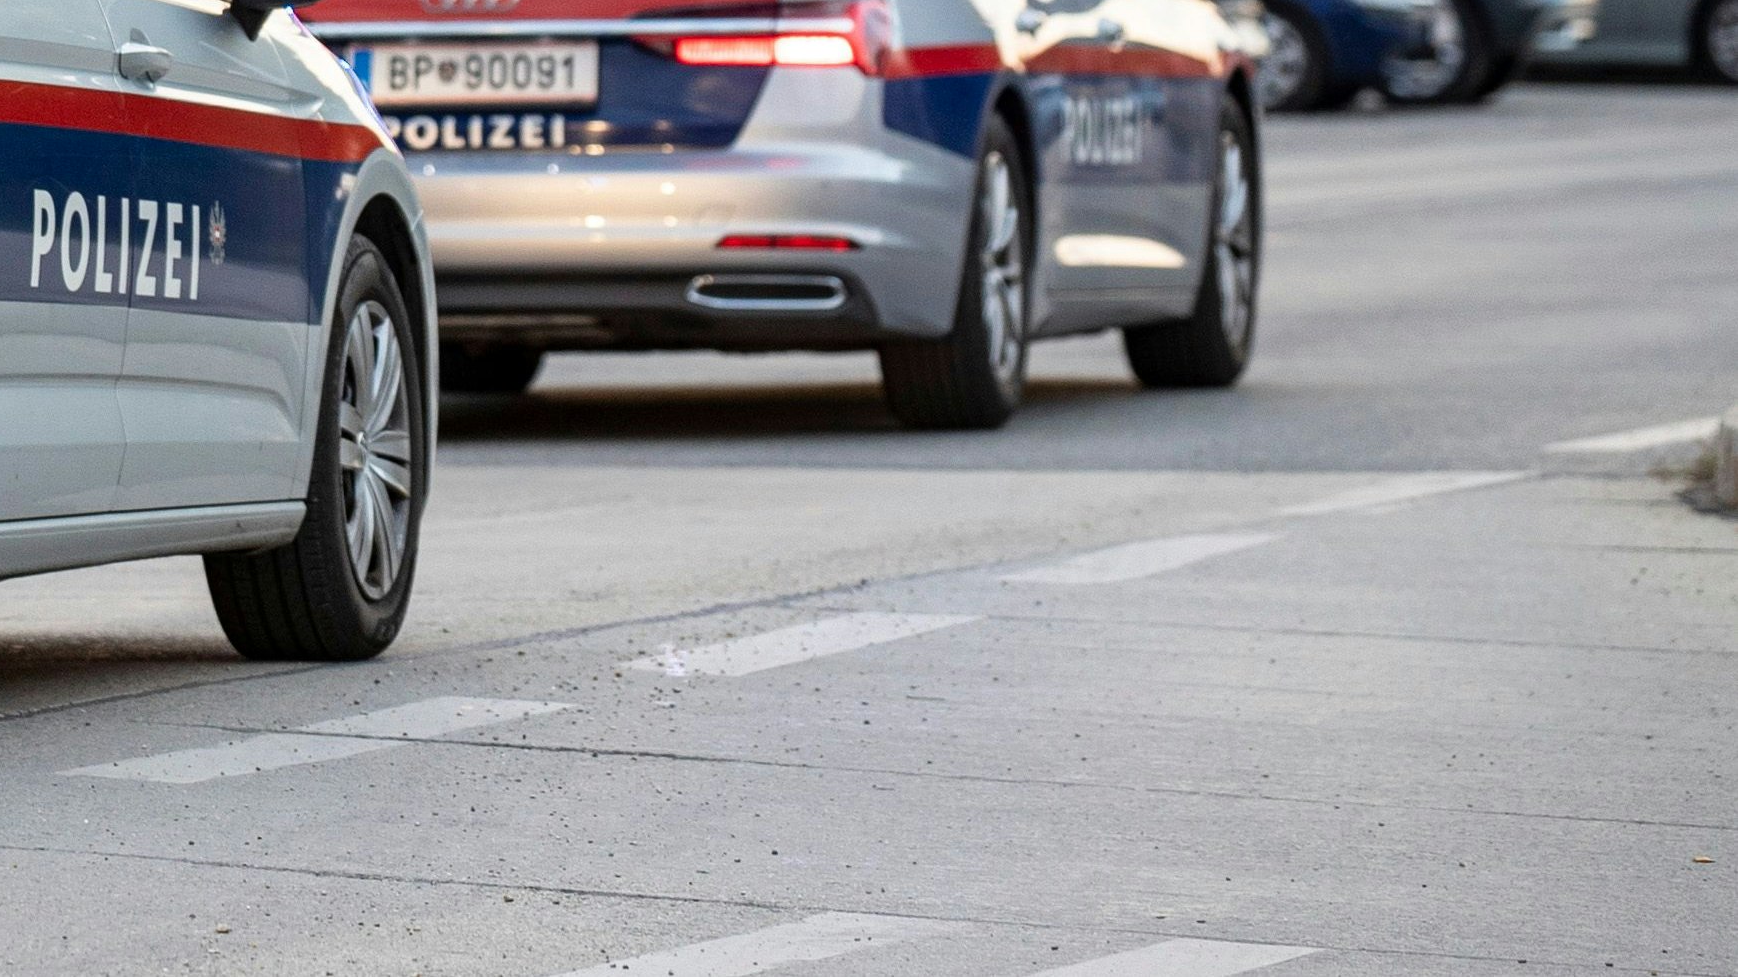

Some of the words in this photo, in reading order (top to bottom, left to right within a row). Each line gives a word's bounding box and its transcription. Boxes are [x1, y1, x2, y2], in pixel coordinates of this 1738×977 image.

[389, 53, 433, 90] BP
[465, 52, 575, 90] 90091
[30, 188, 200, 301] POLIZEI
